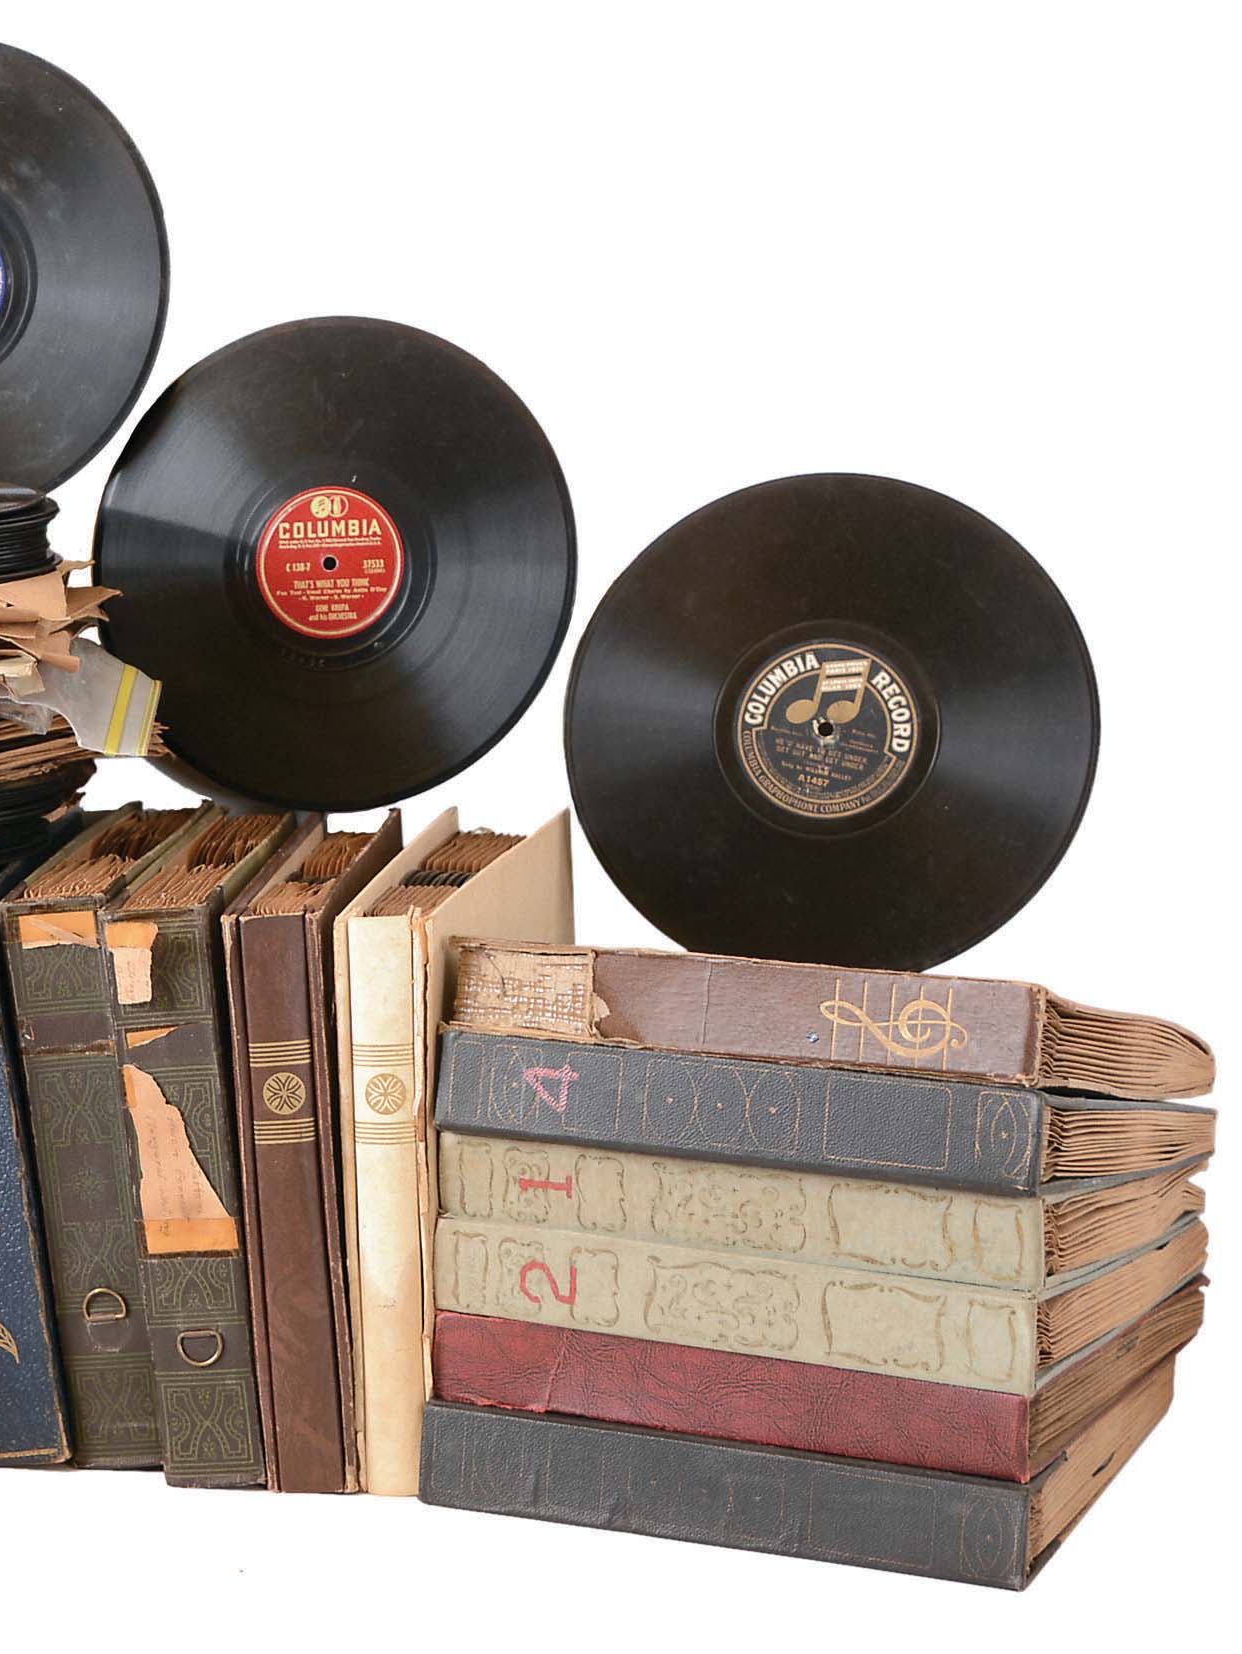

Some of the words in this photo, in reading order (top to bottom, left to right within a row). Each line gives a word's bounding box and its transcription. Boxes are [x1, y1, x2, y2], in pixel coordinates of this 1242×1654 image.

[279, 518, 382, 539] COLUMBIA
[294, 580, 314, 590] THAT'S
[315, 579, 334, 589] WHAT
[336, 578, 350, 588] YOU
[351, 577, 370, 587] THINK
[309, 614, 319, 622] and
[331, 603, 350, 612] KRUPA
[744, 651, 820, 725] COLUMBIA
[870, 669, 912, 752] RECORD
[742, 730, 761, 778] COLUMBIA
[759, 775, 819, 813] GRAPHOPHONE
[820, 799, 862, 813] COMPANY
[523, 1063, 580, 1112] 4
[518, 1174, 573, 1199] 1
[519, 1260, 578, 1305] 2
